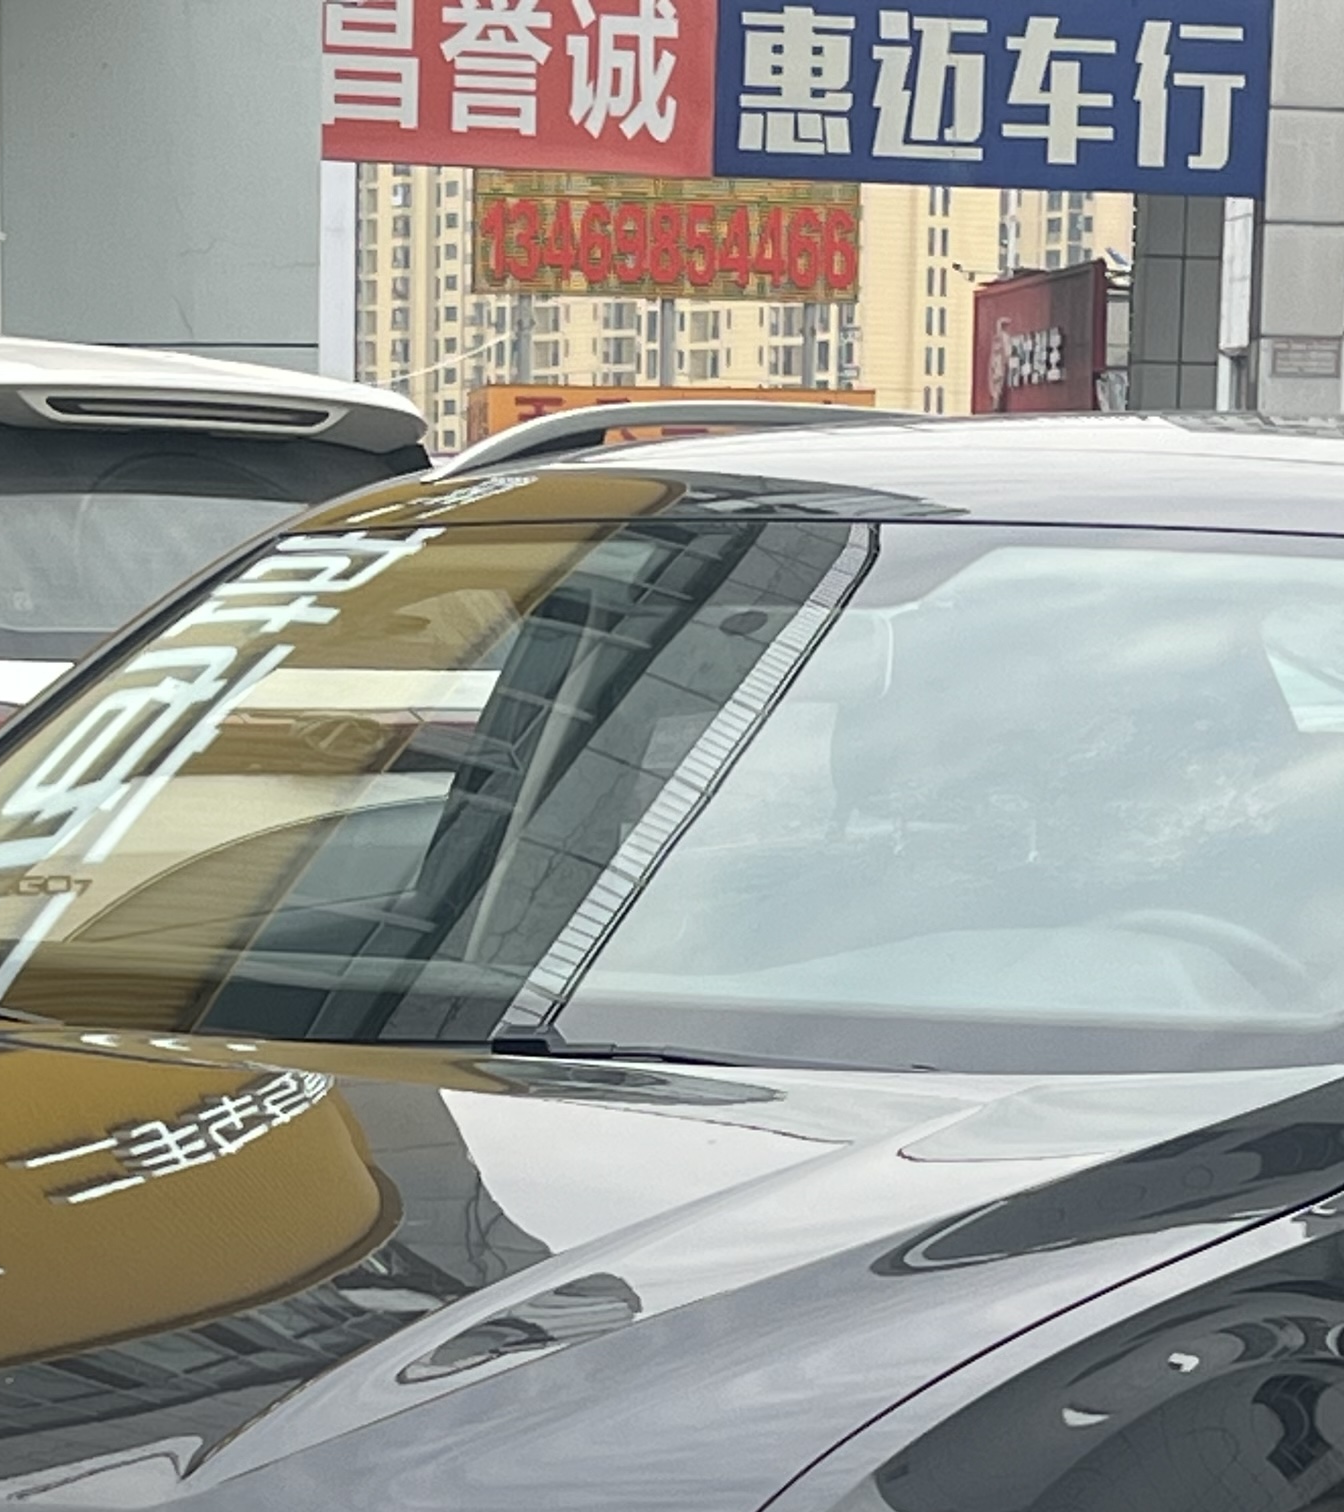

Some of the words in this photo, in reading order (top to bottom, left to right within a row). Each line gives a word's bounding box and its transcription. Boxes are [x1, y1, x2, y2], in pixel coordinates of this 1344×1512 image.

[737, 5, 1247, 171] 惠迈车行
[480, 196, 856, 289] 13469854466
